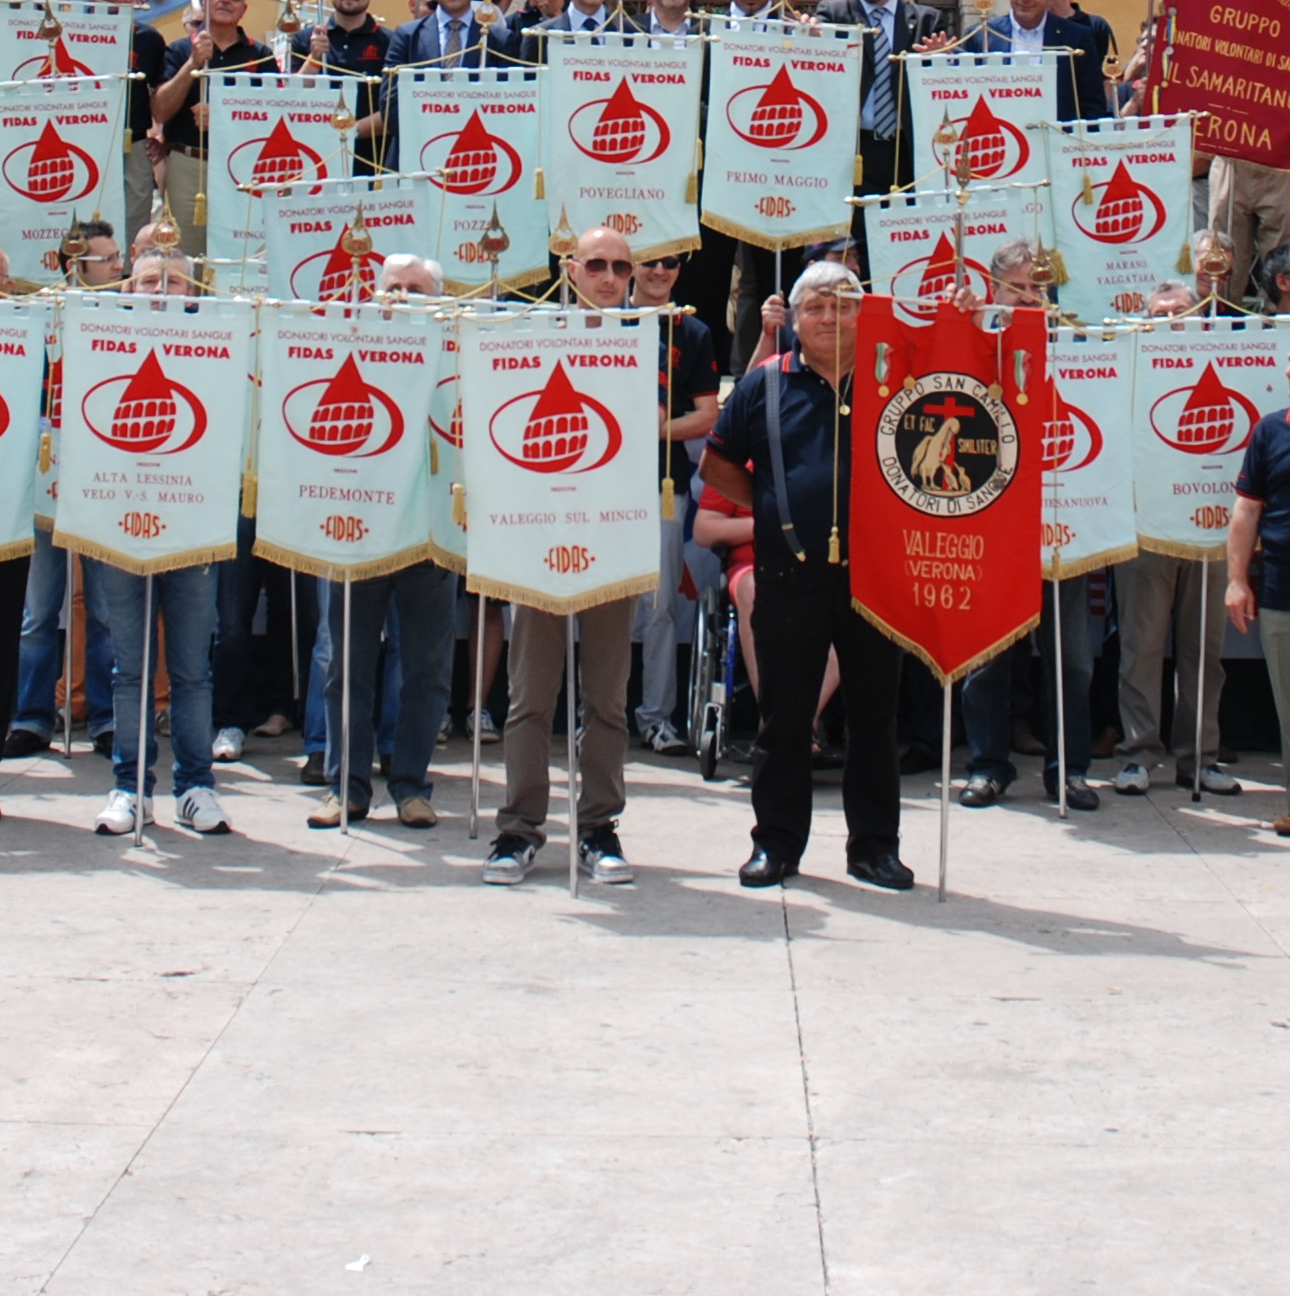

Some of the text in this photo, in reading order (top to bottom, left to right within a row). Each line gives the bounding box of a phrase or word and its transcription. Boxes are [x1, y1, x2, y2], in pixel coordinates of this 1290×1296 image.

[1210, 5, 1281, 38] GRUPPO
[1215, 34, 1263, 65] VOLONTARI
[1266, 51, 1277, 67] DI
[733, 56, 845, 73] FIDAS VERONA
[726, 170, 828, 188] PRIMO MAGGIO
[580, 188, 664, 199] POVEGLIANO
[92, 339, 230, 359] FIDAS VERONA
[479, 337, 638, 352] DONATORI VOLONTARI SANGUE
[288, 346, 424, 364] FIDAS VERONA
[492, 355, 637, 371] FIDAS VERONA
[1152, 356, 1276, 369] FIDAS VERONA
[880, 375, 966, 436] GRUPPO SAN
[904, 417, 936, 432] ET FAC
[957, 438, 998, 454] SIMILITER
[93, 471, 192, 486] ALTA LESSINIA
[882, 455, 961, 514] DONATORI DI
[82, 489, 204, 504] VELO MAURO
[300, 485, 394, 504] PEDEMONTE
[490, 510, 648, 525] VALEGGIO SUL MINCIO
[903, 530, 984, 560] VALEGGIO
[912, 582, 971, 610] 1962
